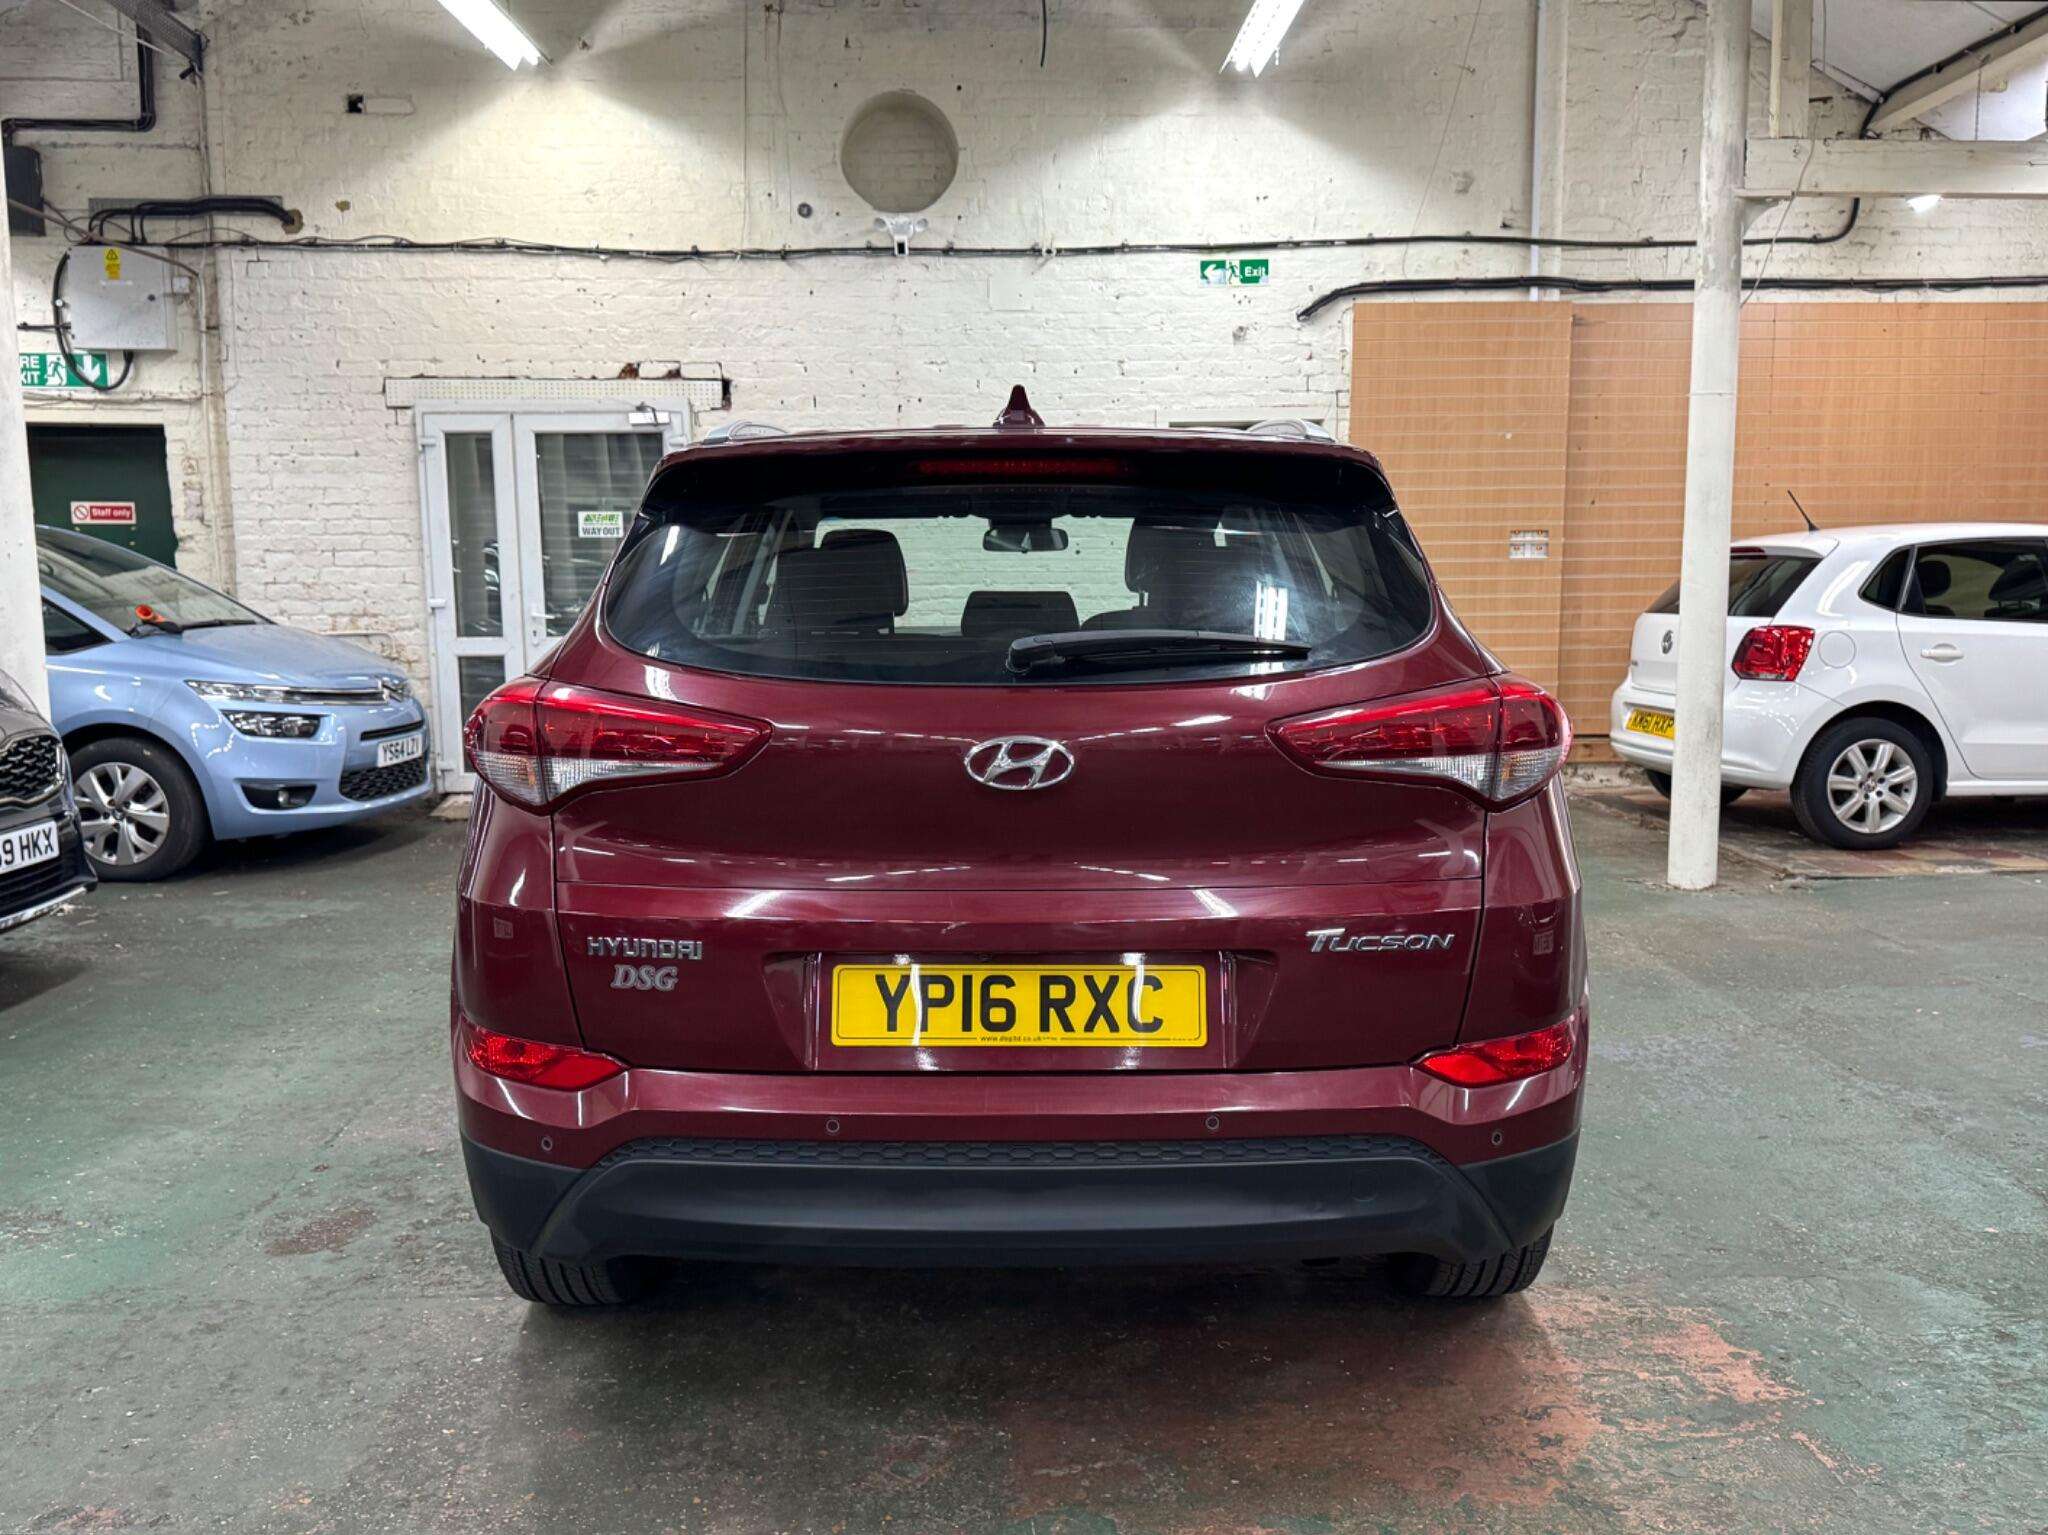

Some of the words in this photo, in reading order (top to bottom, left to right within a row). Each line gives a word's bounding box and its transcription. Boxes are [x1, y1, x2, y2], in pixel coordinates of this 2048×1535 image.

[1245, 266, 1265, 277] Exit
[20, 355, 39, 369] RE
[21, 371, 40, 384] XIT
[582, 527, 601, 536] WAY
[602, 527, 620, 536] OUT
[19, 827, 54, 861] HKX
[587, 936, 702, 960] HYUNDAI
[610, 964, 679, 991] DSG
[875, 974, 1016, 1033] YP16
[1039, 974, 1164, 1033] RXC
